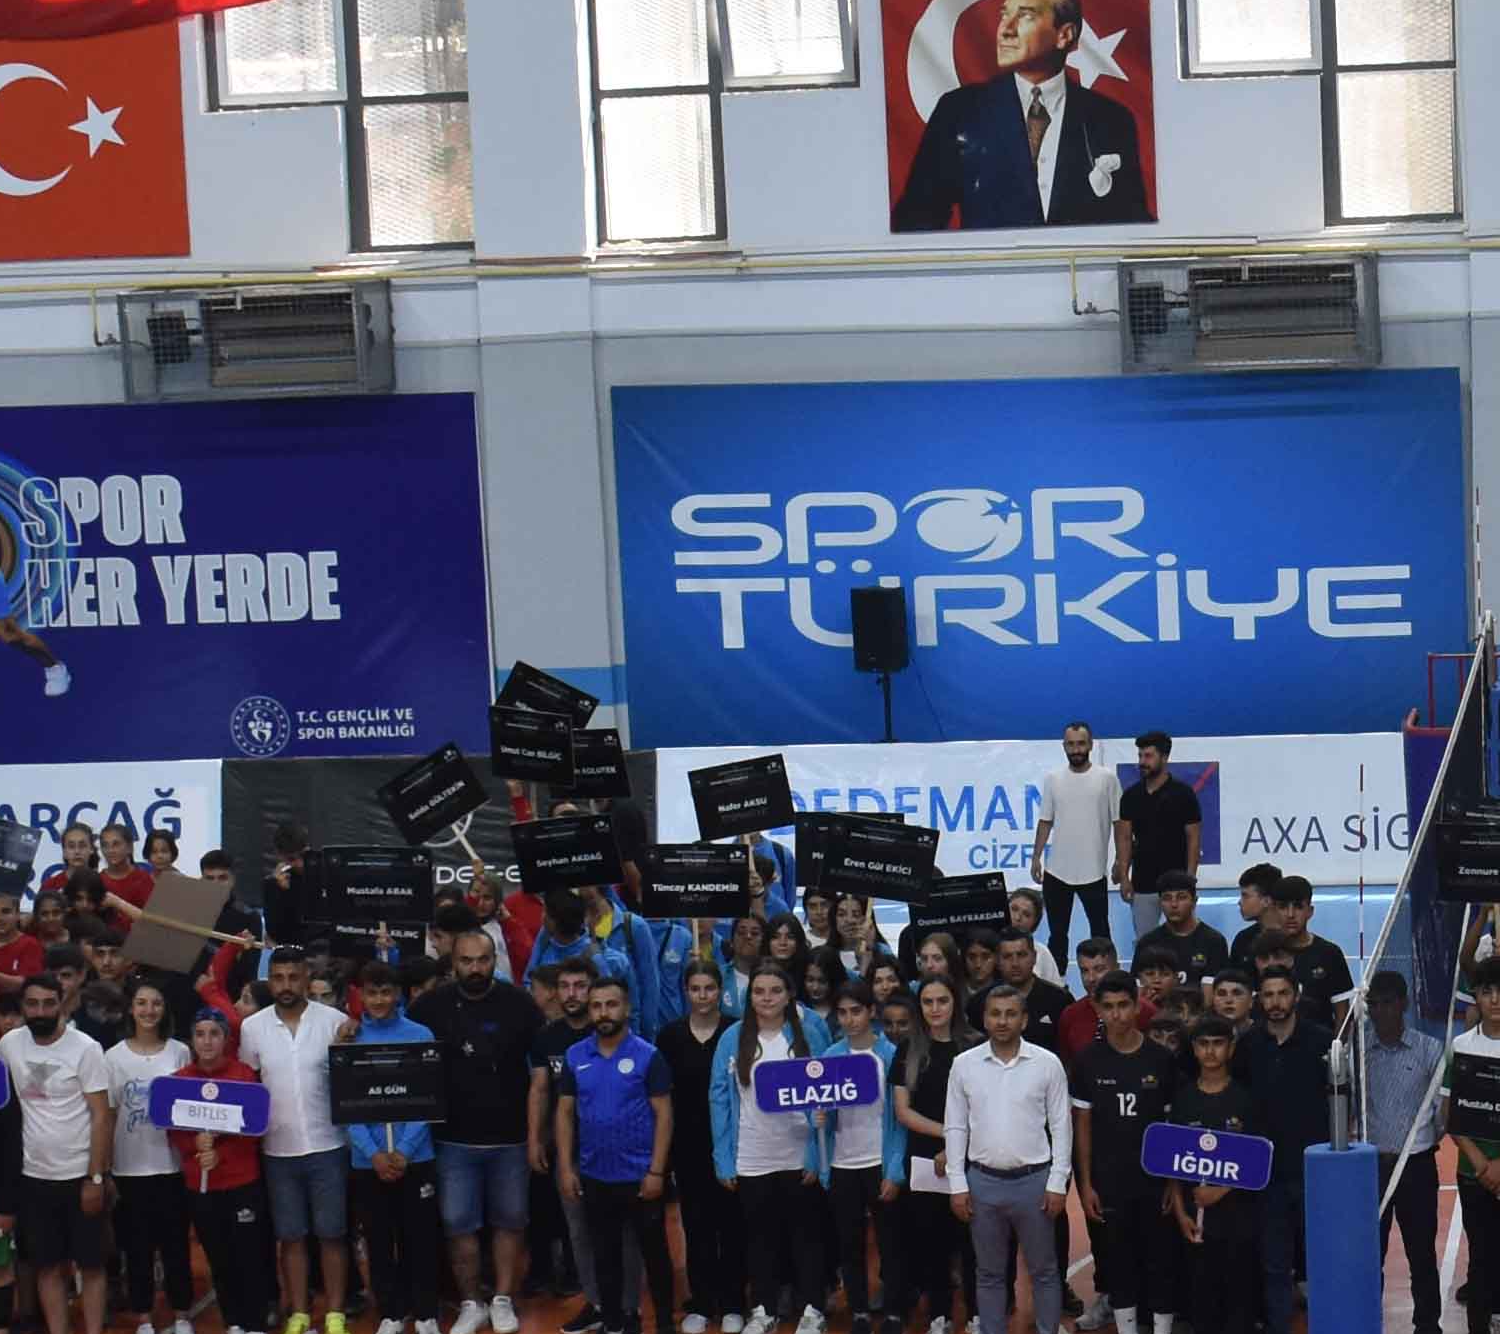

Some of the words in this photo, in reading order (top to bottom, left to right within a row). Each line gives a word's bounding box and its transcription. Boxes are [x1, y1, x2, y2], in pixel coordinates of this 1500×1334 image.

[18, 475, 185, 548] SPOR
[671, 485, 1150, 565] SPOR
[26, 557, 139, 628] HER
[152, 551, 341, 625] YERDE
[674, 552, 1413, 650] TÜRKİYE
[296, 711, 322, 724] T.C.
[326, 707, 389, 725] GENÇLİK
[395, 708, 414, 721] VE
[297, 726, 334, 740] SPOR
[338, 721, 415, 739] BAKANLIĞI
[1242, 817, 1328, 854] AXA
[844, 857, 866, 868] Eren
[688, 882, 740, 892] KANDEMİR
[778, 1078, 858, 1107] ELAZIĞ
[1117, 1092, 1138, 1117] 12
[1457, 1097, 1494, 1111] Mustafa
[1173, 1151, 1240, 1181] IĞDIR
